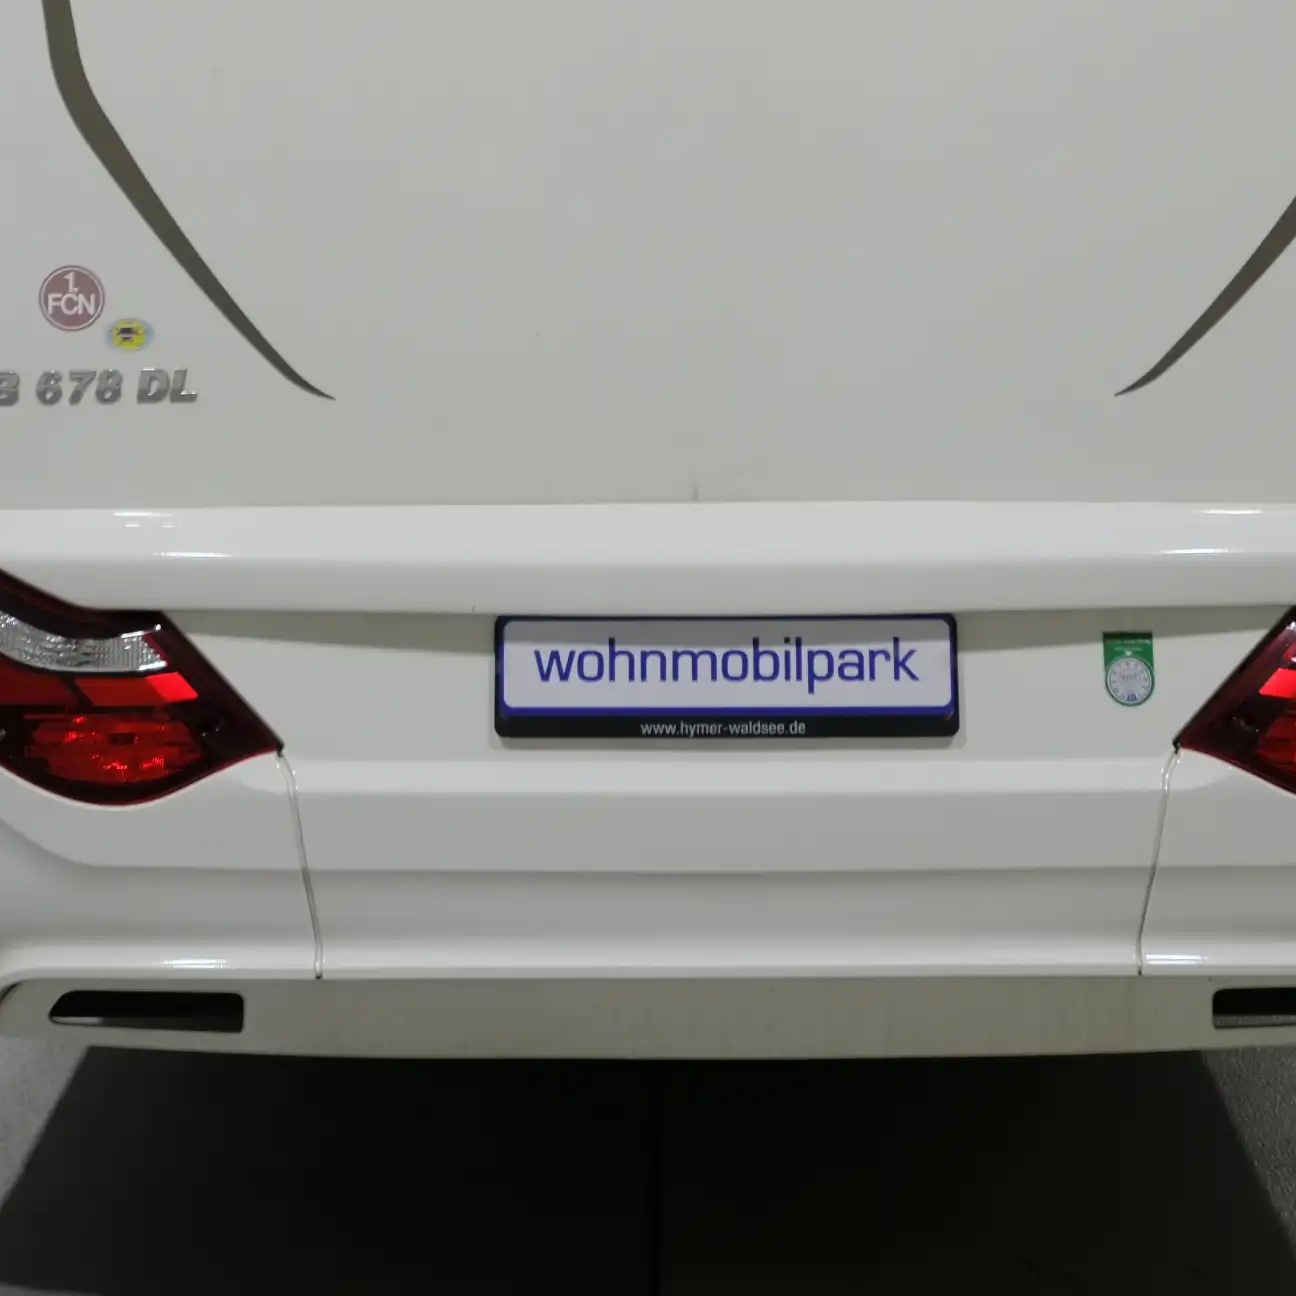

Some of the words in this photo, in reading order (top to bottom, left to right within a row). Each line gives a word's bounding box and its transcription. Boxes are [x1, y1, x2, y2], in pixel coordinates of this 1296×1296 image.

[47, 294, 95, 315] FCN
[36, 369, 123, 405] 678
[137, 368, 198, 403] DL
[534, 636, 920, 694] wohnmobilpark
[640, 720, 806, 737] www.hymer-waldsee.de
